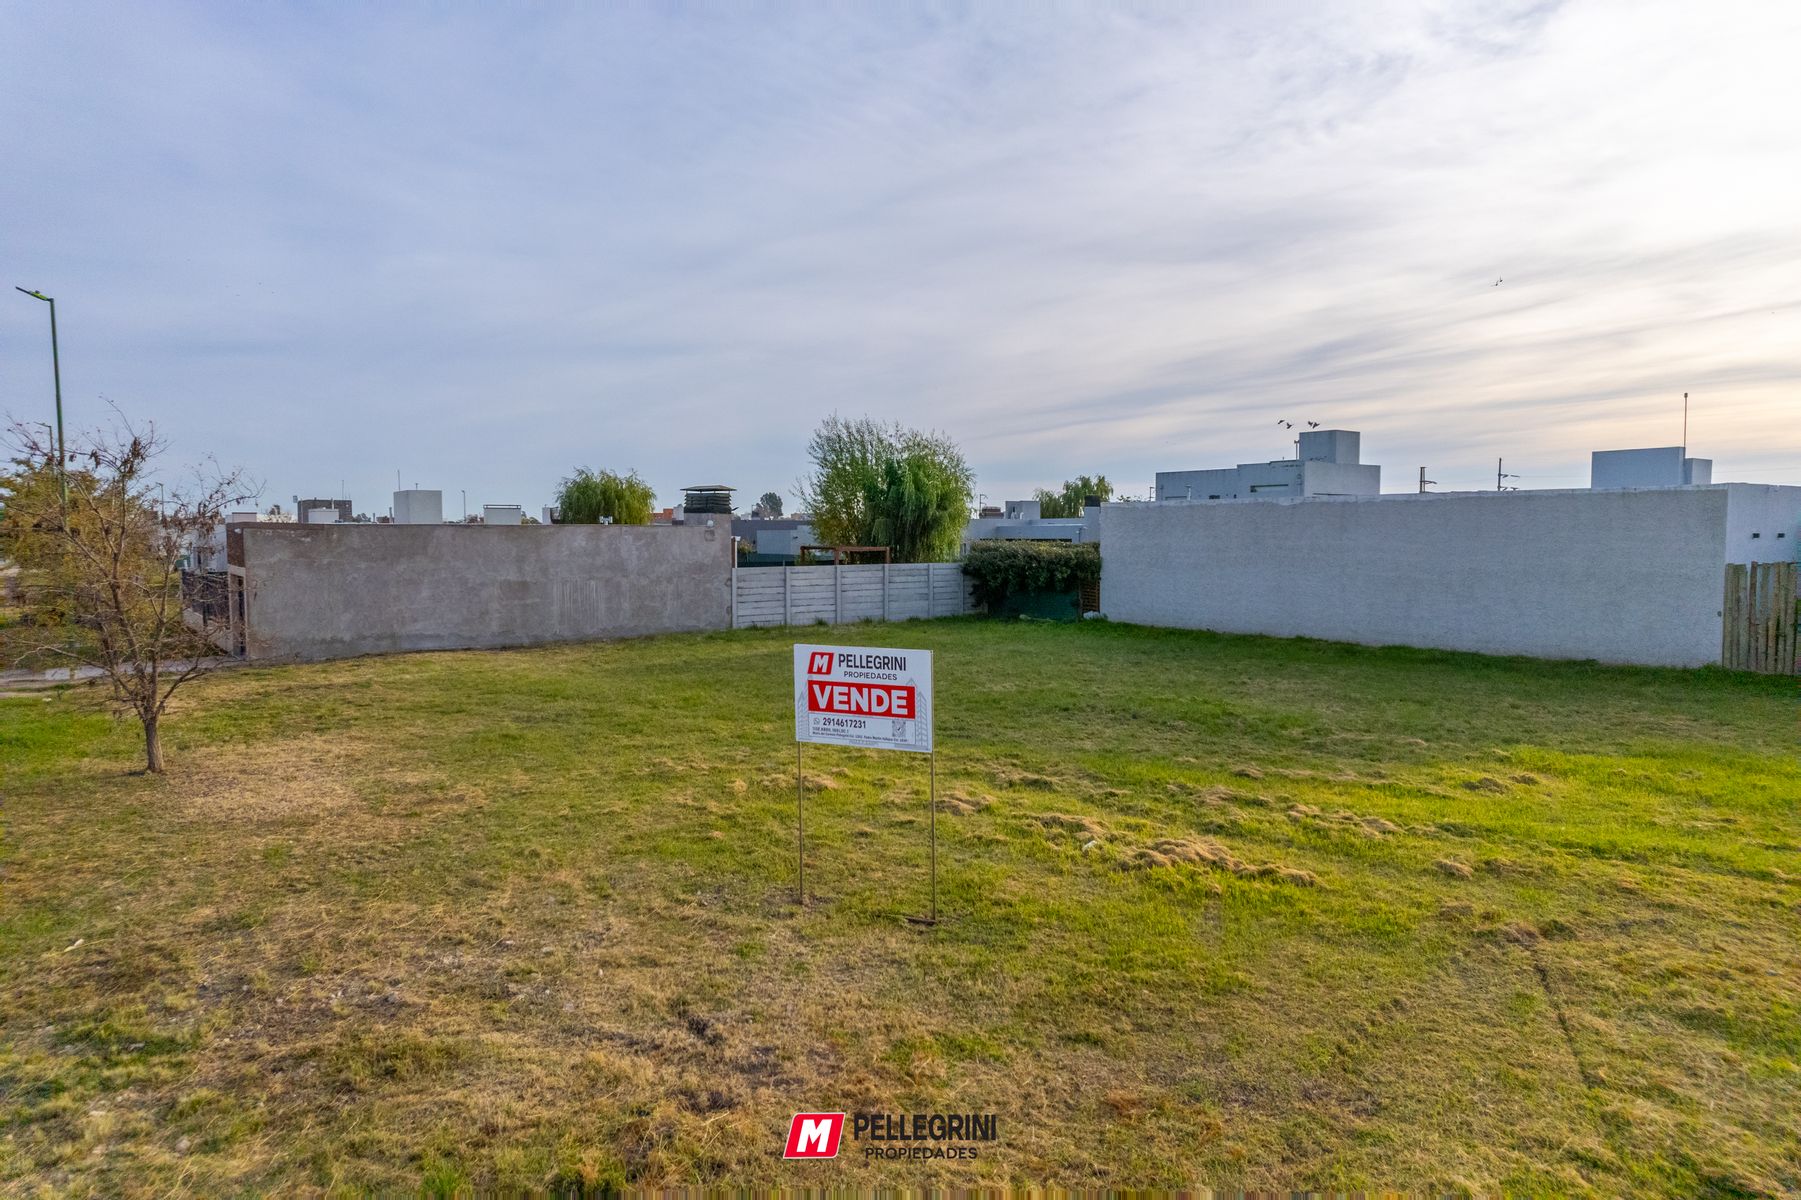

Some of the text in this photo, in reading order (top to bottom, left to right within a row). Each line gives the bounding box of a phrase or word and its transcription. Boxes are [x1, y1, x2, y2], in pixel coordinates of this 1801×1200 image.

[812, 653, 907, 673] M PELLEGRINI
[843, 670, 898, 681] PROPIEDADES
[812, 684, 909, 716] VENDE
[822, 717, 867, 729] 2914617231
